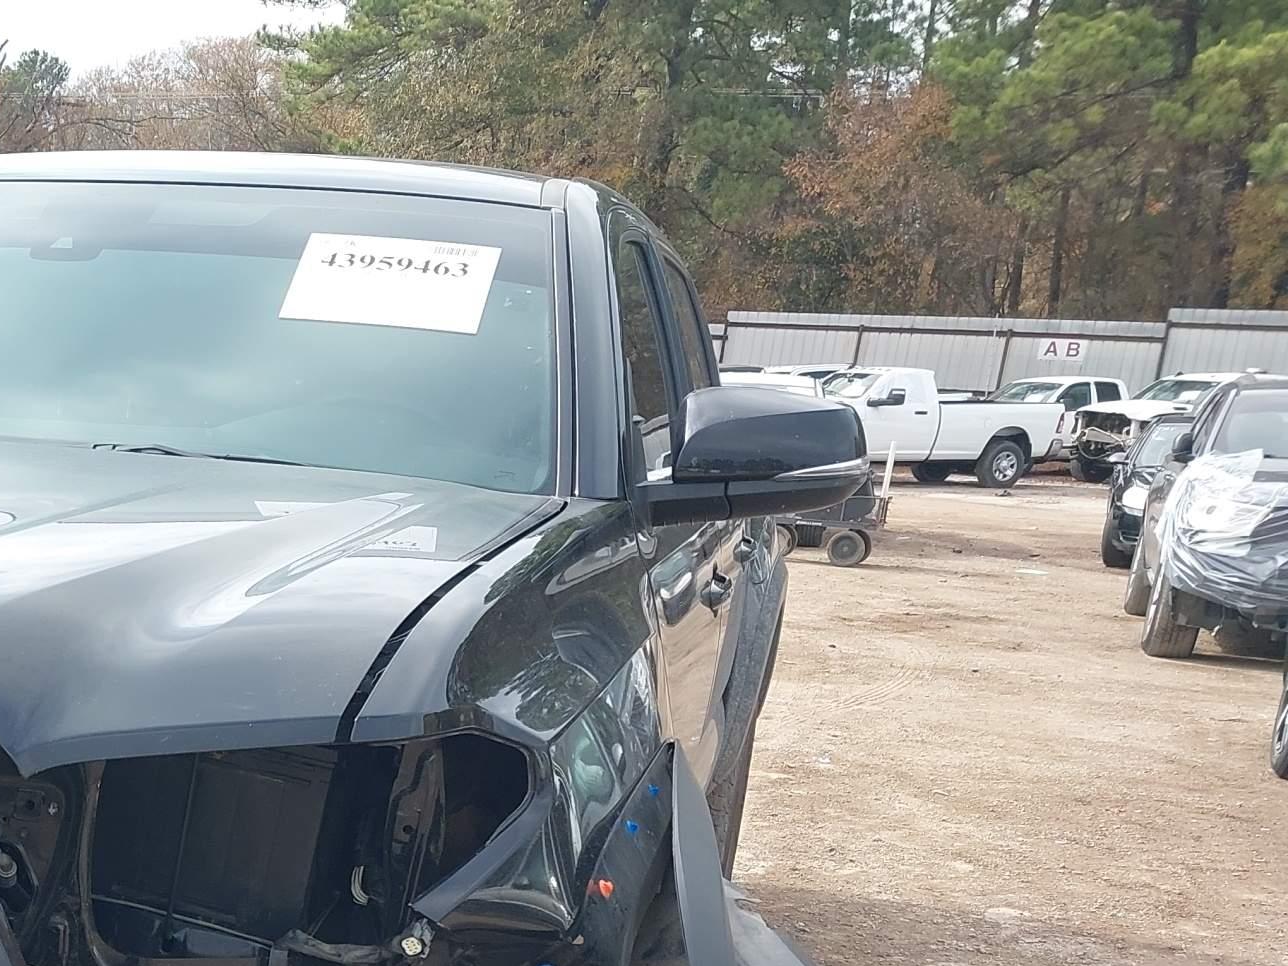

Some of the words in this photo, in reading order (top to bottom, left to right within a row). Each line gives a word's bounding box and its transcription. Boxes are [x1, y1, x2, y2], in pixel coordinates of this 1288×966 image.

[320, 252, 470, 278] 43959463
[1043, 341, 1058, 357] A
[1065, 341, 1081, 357] B
